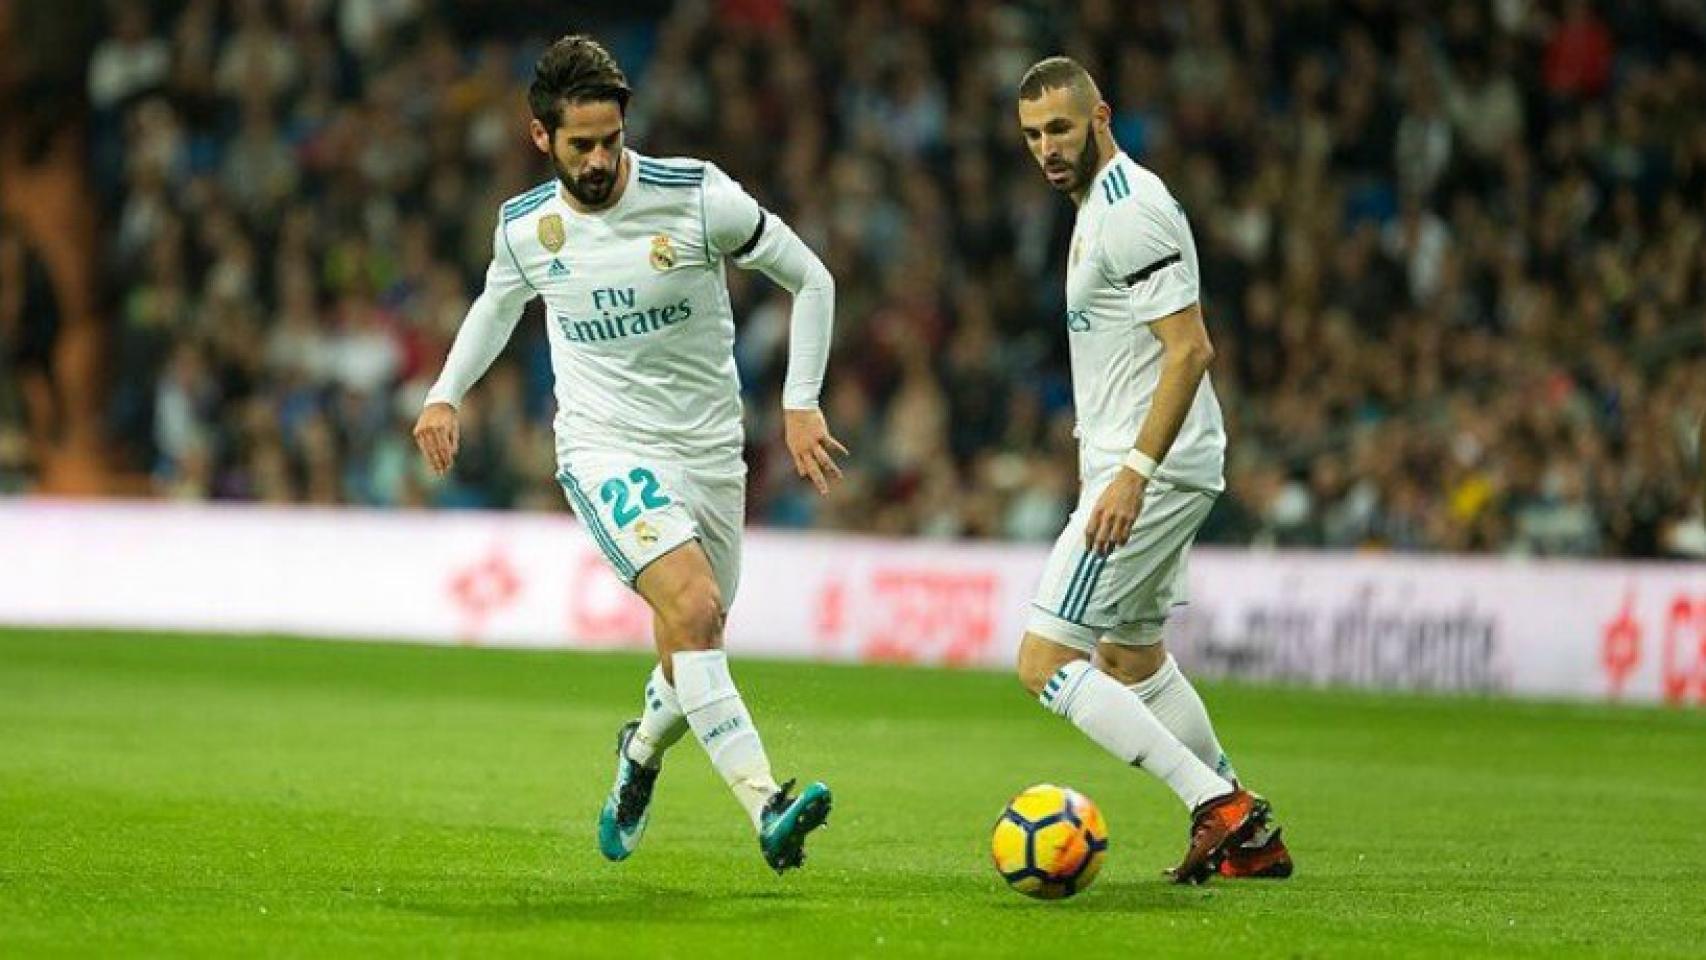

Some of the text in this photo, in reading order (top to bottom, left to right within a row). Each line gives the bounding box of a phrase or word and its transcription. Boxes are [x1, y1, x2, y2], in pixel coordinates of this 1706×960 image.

[557, 298, 692, 342] Emirates
[592, 287, 636, 310] Fly
[600, 467, 671, 529] 22
